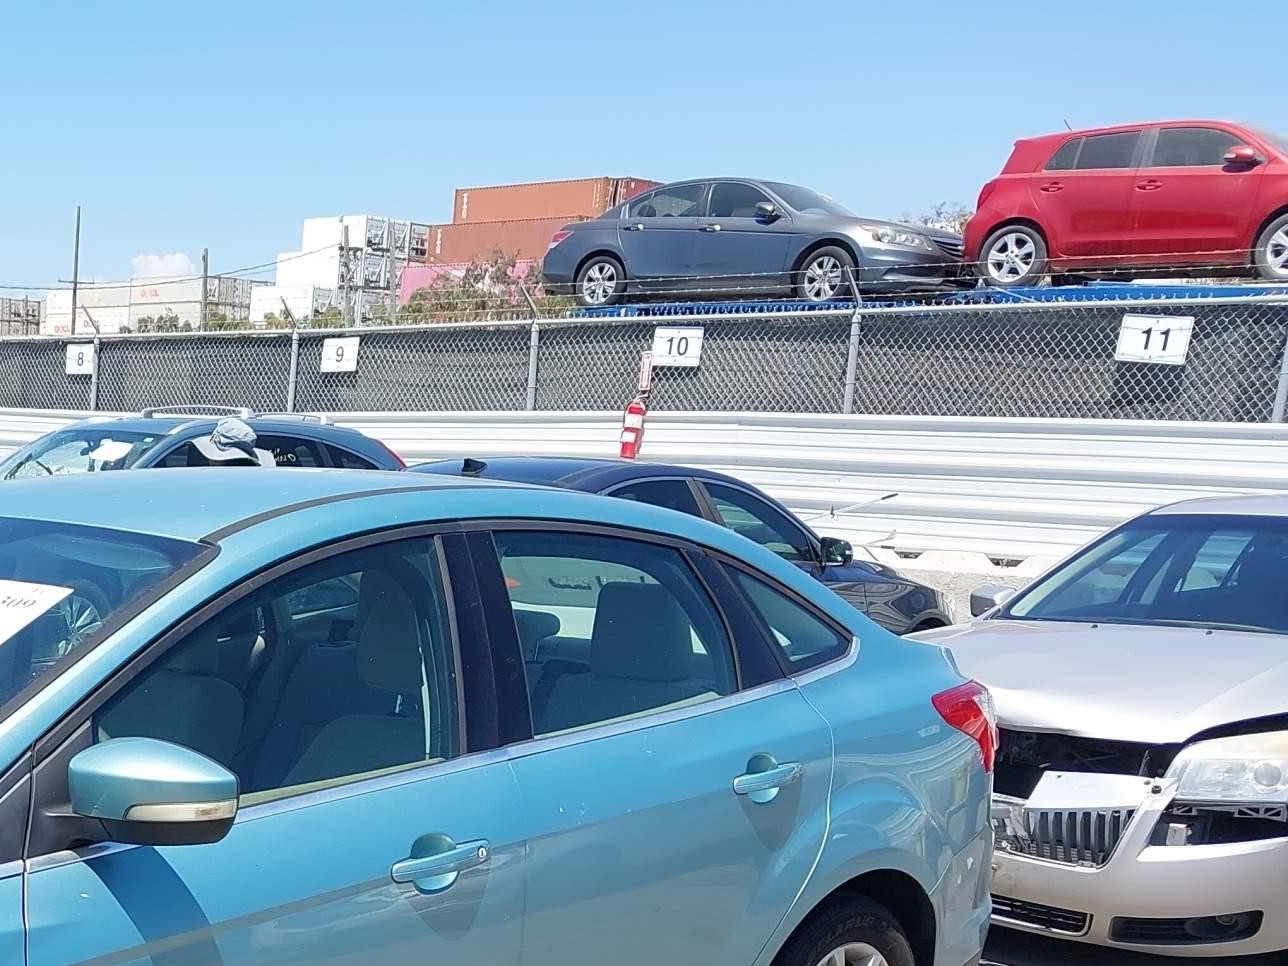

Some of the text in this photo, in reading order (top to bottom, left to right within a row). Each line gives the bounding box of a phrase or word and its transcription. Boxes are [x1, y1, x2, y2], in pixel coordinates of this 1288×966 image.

[666, 336, 689, 356] 10
[1141, 327, 1171, 351] 11
[77, 351, 84, 367] 8
[336, 345, 344, 362] 9
